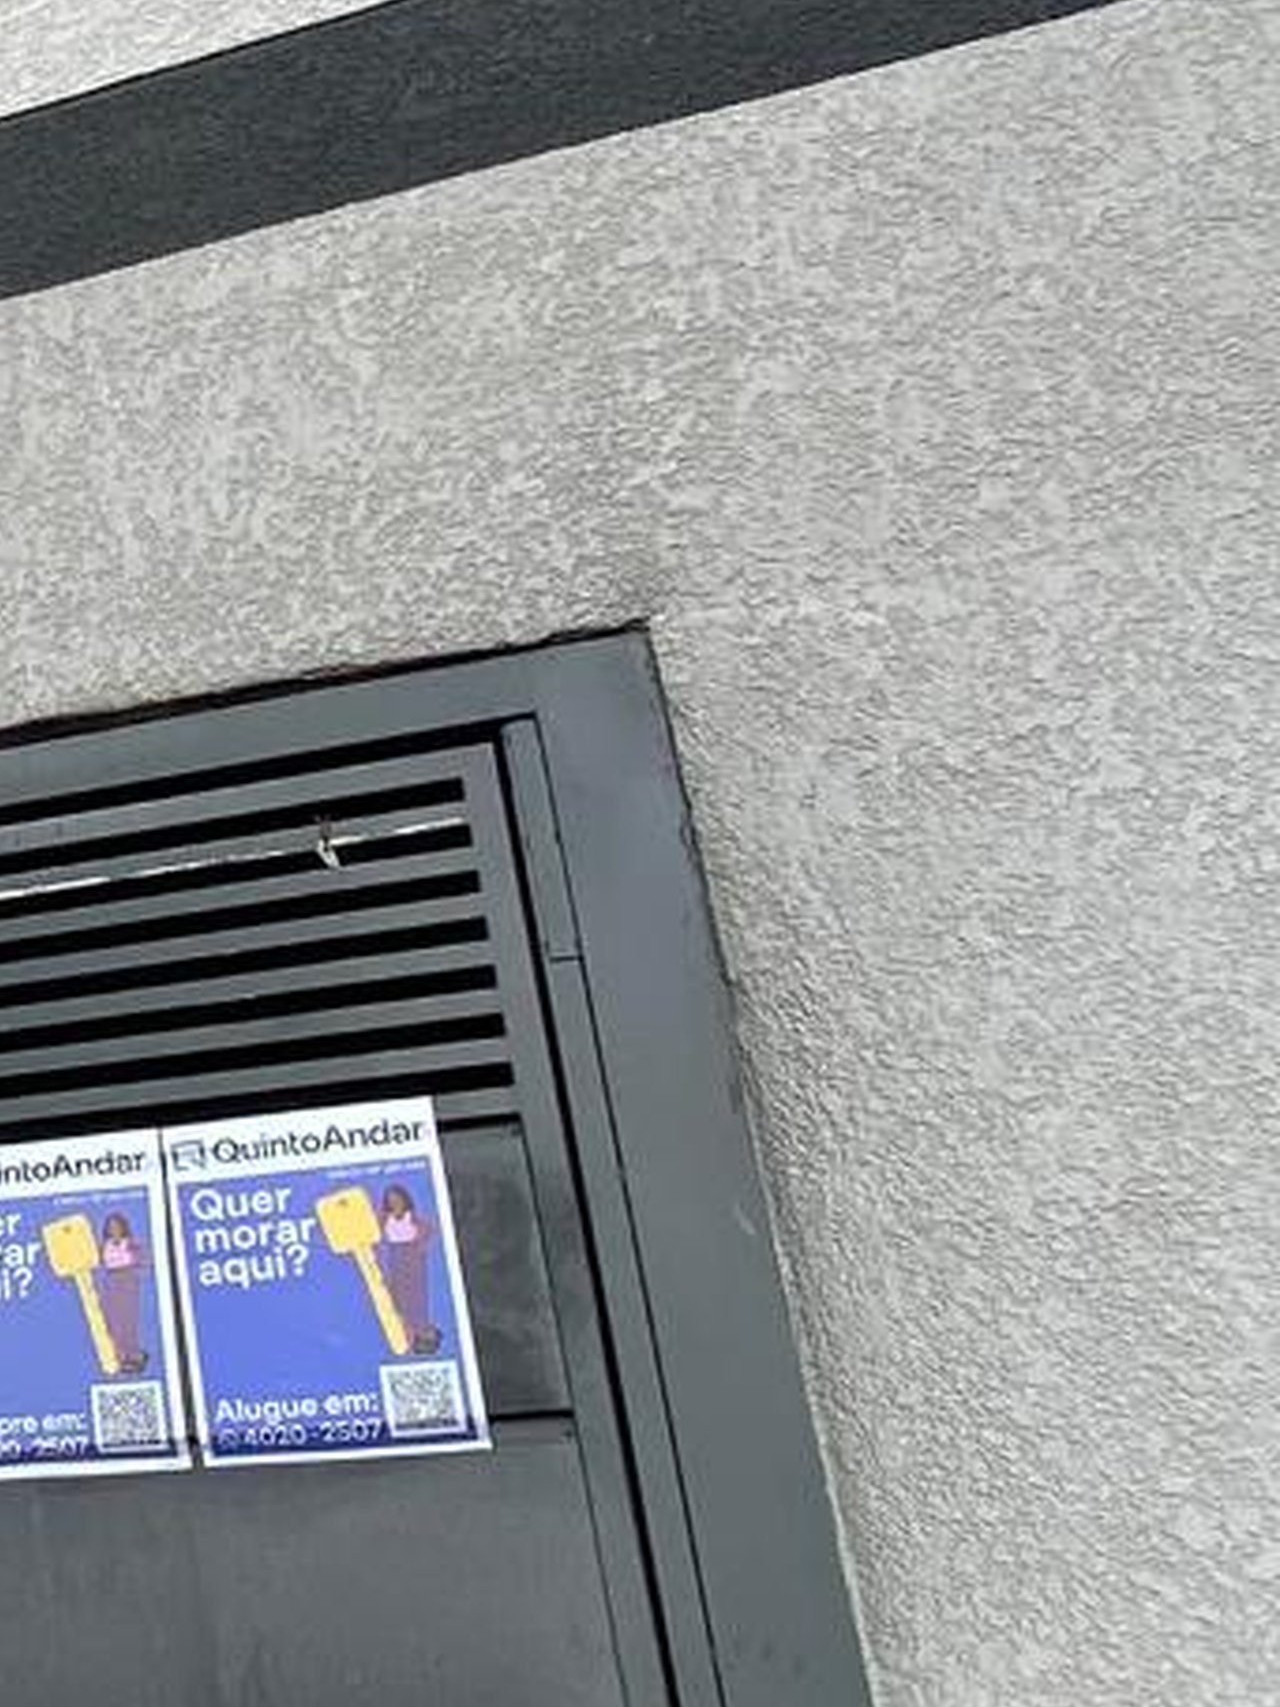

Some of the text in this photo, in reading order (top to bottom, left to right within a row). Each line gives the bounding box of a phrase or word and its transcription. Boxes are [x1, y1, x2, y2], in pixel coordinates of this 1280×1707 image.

[212, 1119, 425, 1165] QuintoAndar
[191, 1187, 292, 1222] Quer
[195, 1217, 317, 1253] morar
[199, 1243, 310, 1289] aqui?
[42, 1412, 87, 1432] em:
[214, 1392, 380, 1426] Alugue em:
